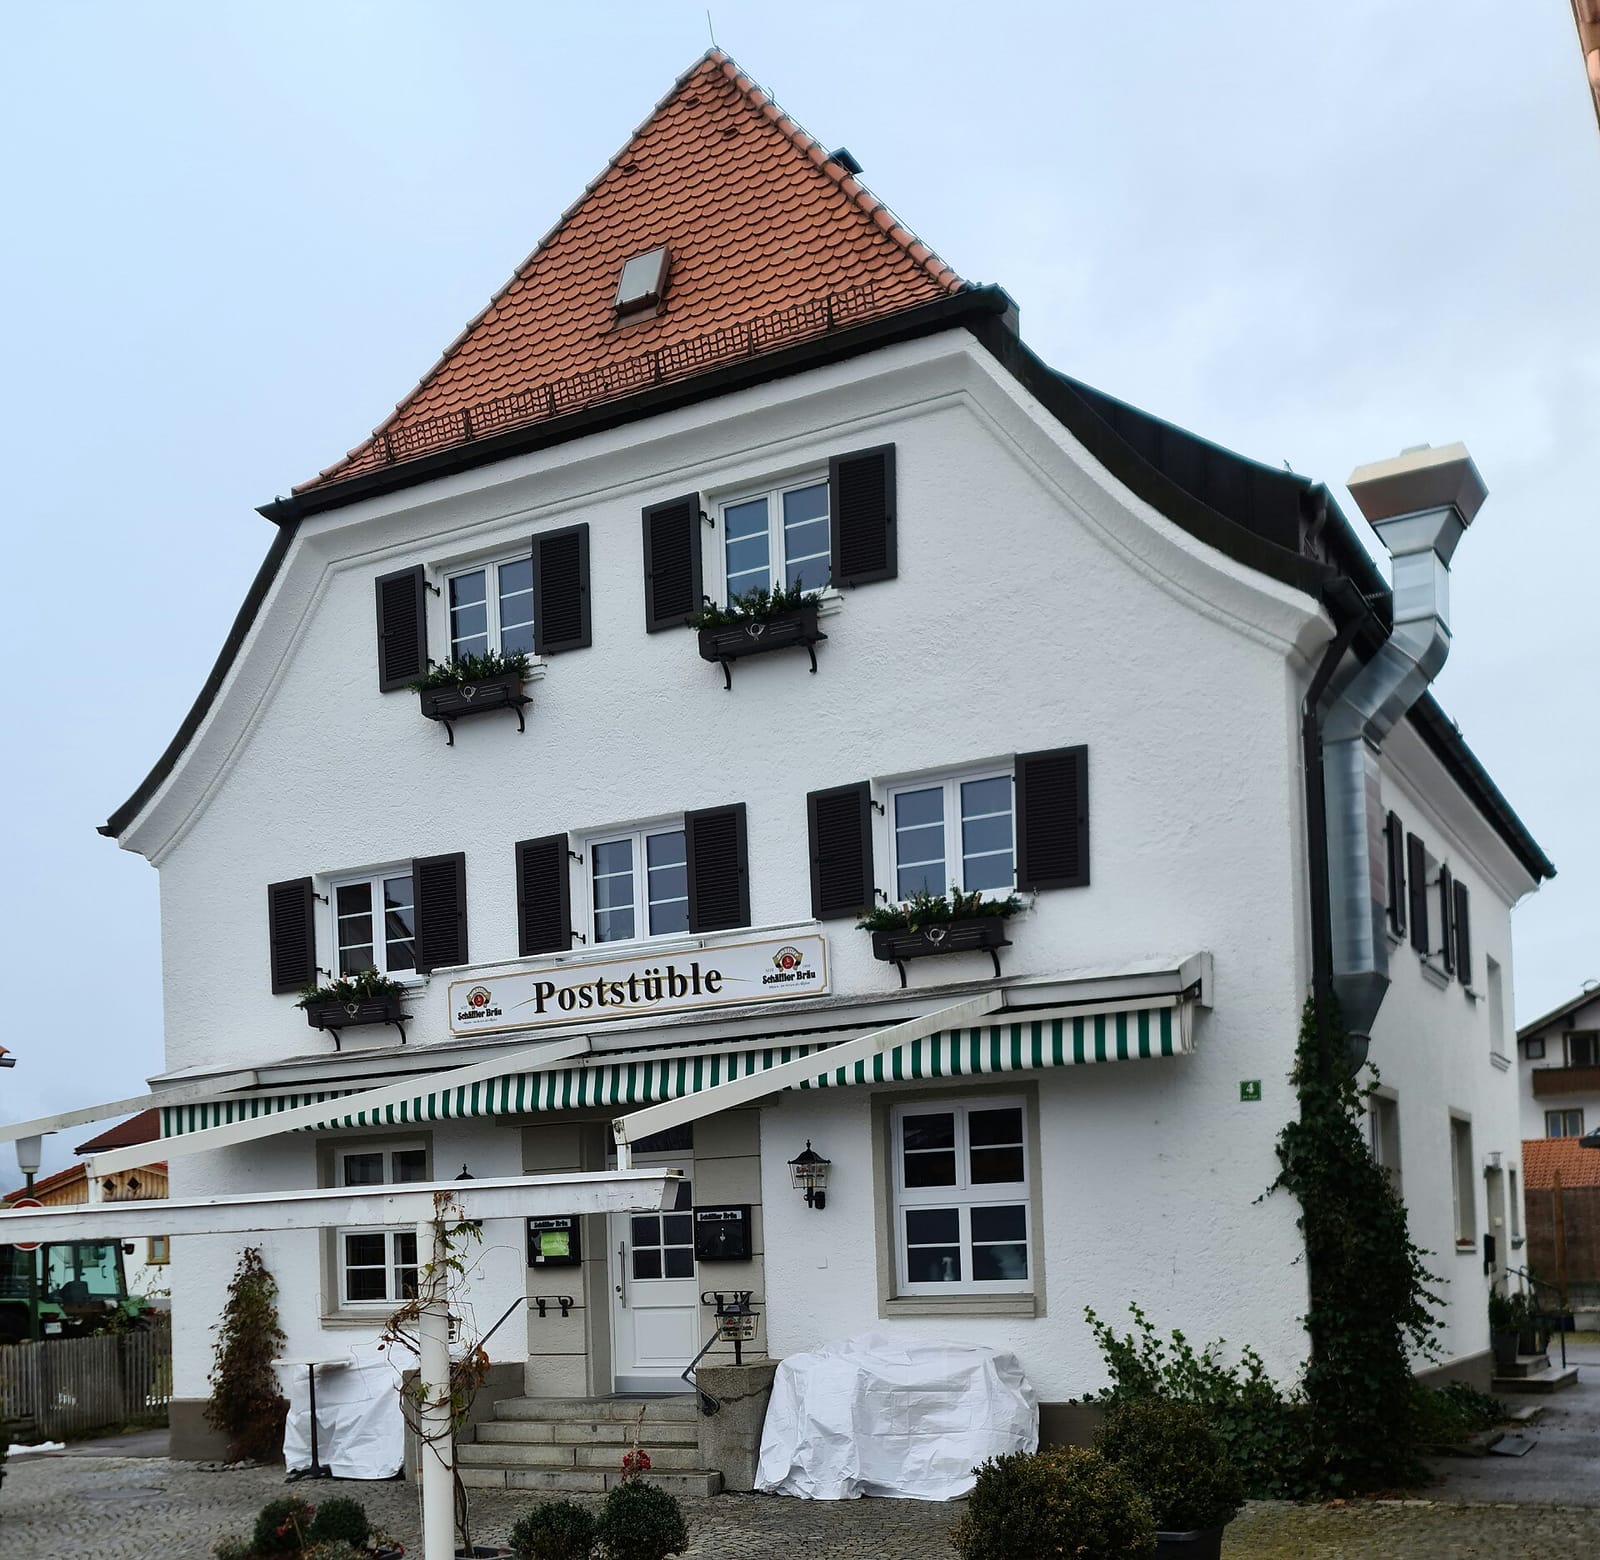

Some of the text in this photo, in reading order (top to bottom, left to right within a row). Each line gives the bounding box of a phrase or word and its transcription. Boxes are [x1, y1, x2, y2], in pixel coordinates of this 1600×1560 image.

[796, 970, 816, 980] Bräu
[533, 962, 722, 1013] Poststüble
[486, 1008, 502, 1016] Bräu
[1246, 1082, 1254, 1093] 4
